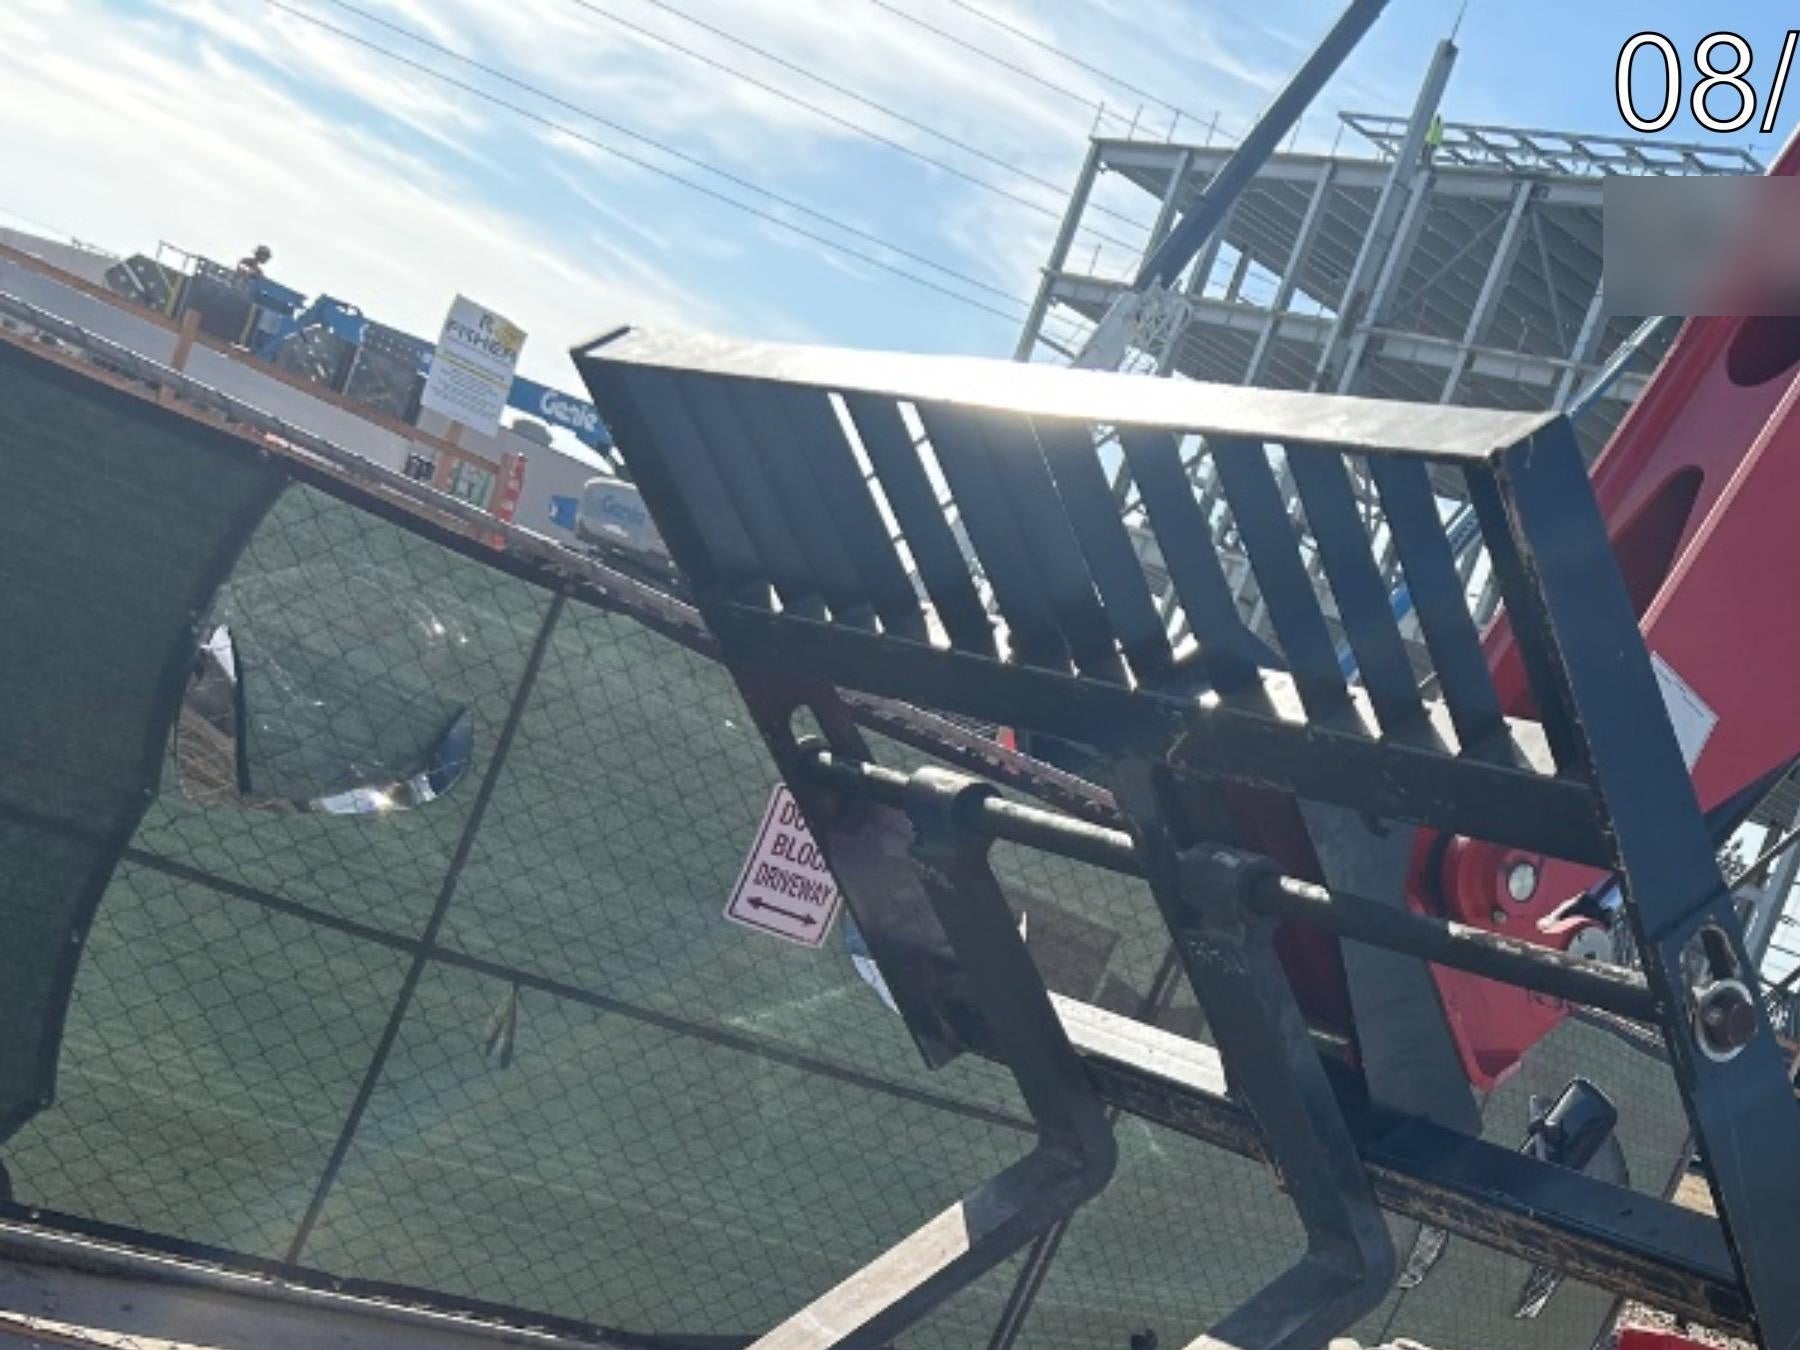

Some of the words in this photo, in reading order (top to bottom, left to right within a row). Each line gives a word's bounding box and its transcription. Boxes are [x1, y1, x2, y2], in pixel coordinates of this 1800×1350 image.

[539, 391, 598, 432] Genie
[771, 833, 828, 873] BLOC
[753, 862, 833, 907] DRIVEWAY
